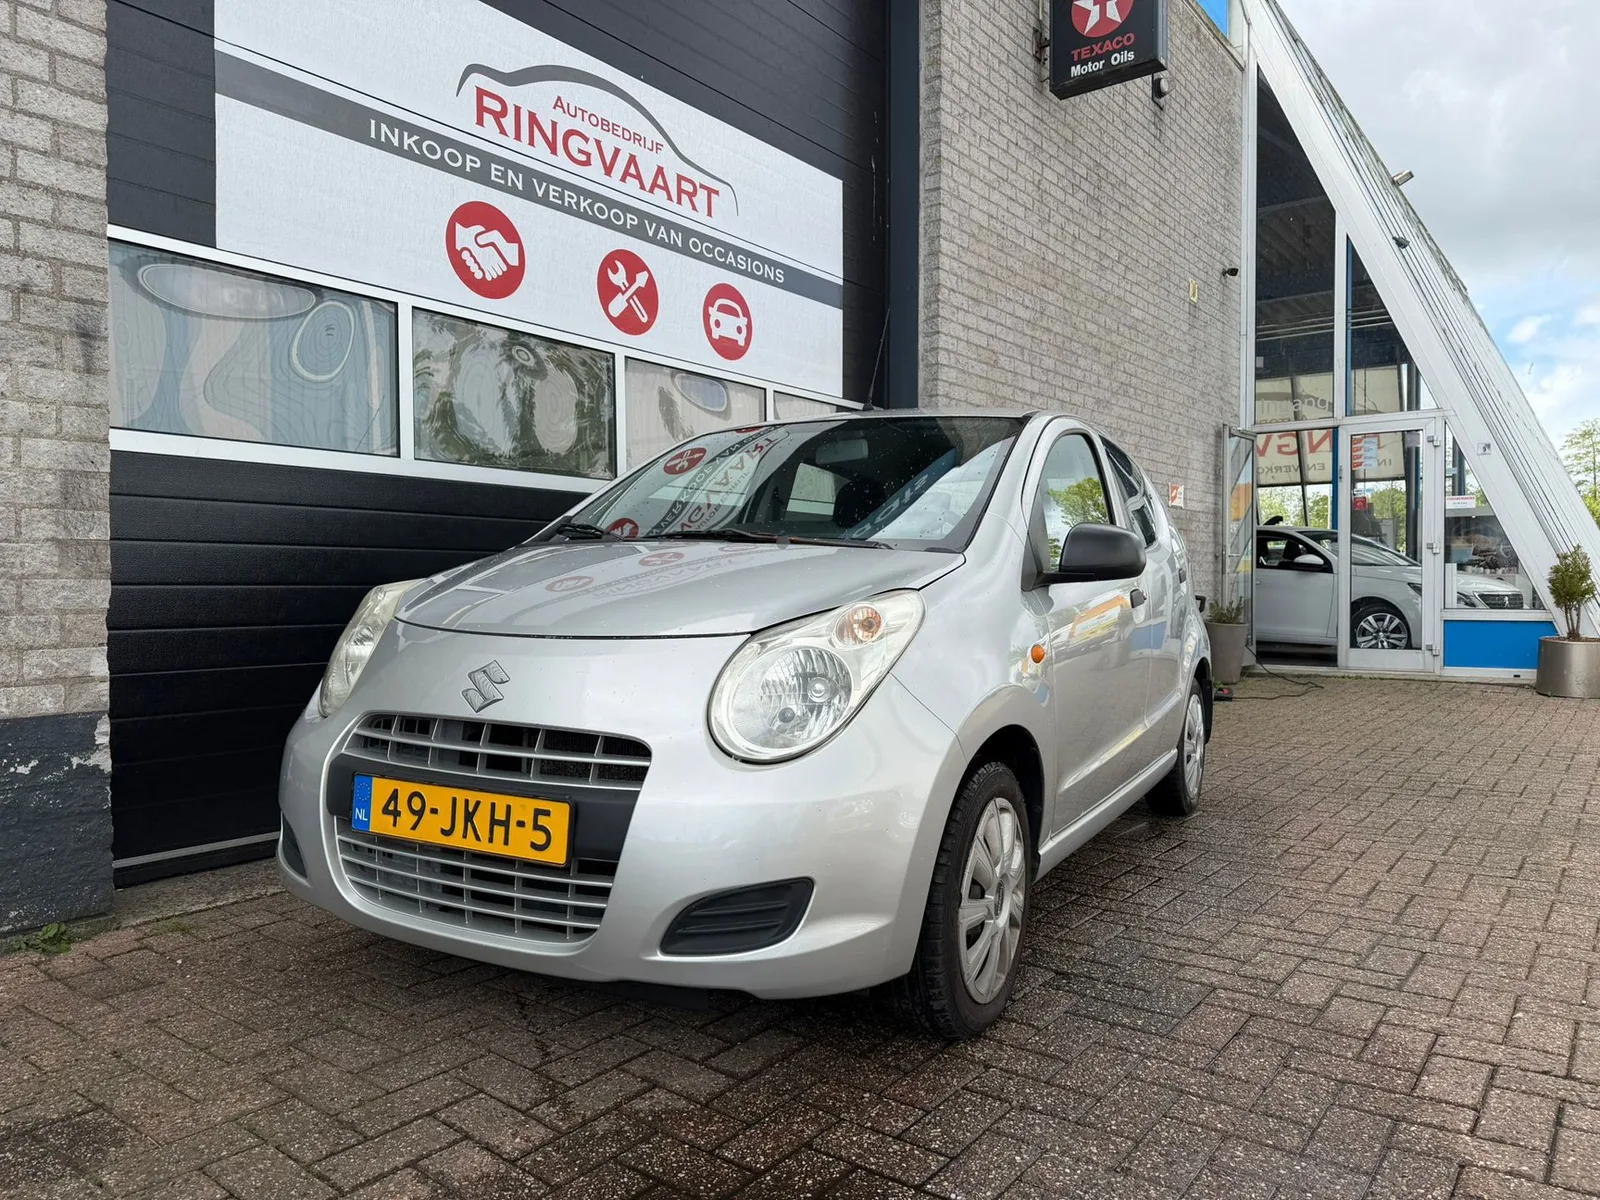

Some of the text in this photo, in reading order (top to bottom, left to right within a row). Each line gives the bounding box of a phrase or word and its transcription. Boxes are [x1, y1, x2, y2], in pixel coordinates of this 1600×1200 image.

[1071, 33, 1135, 61] TEXACO
[1071, 50, 1134, 77] Motor Oils
[475, 86, 719, 218] RINGVAART
[552, 95, 664, 154] AUTOBEDRIJF
[369, 119, 784, 283] INKOOP EN VERKOOP VAN OCCASIONS
[355, 808, 368, 821] NL
[382, 788, 552, 852] 49-JKH-5
